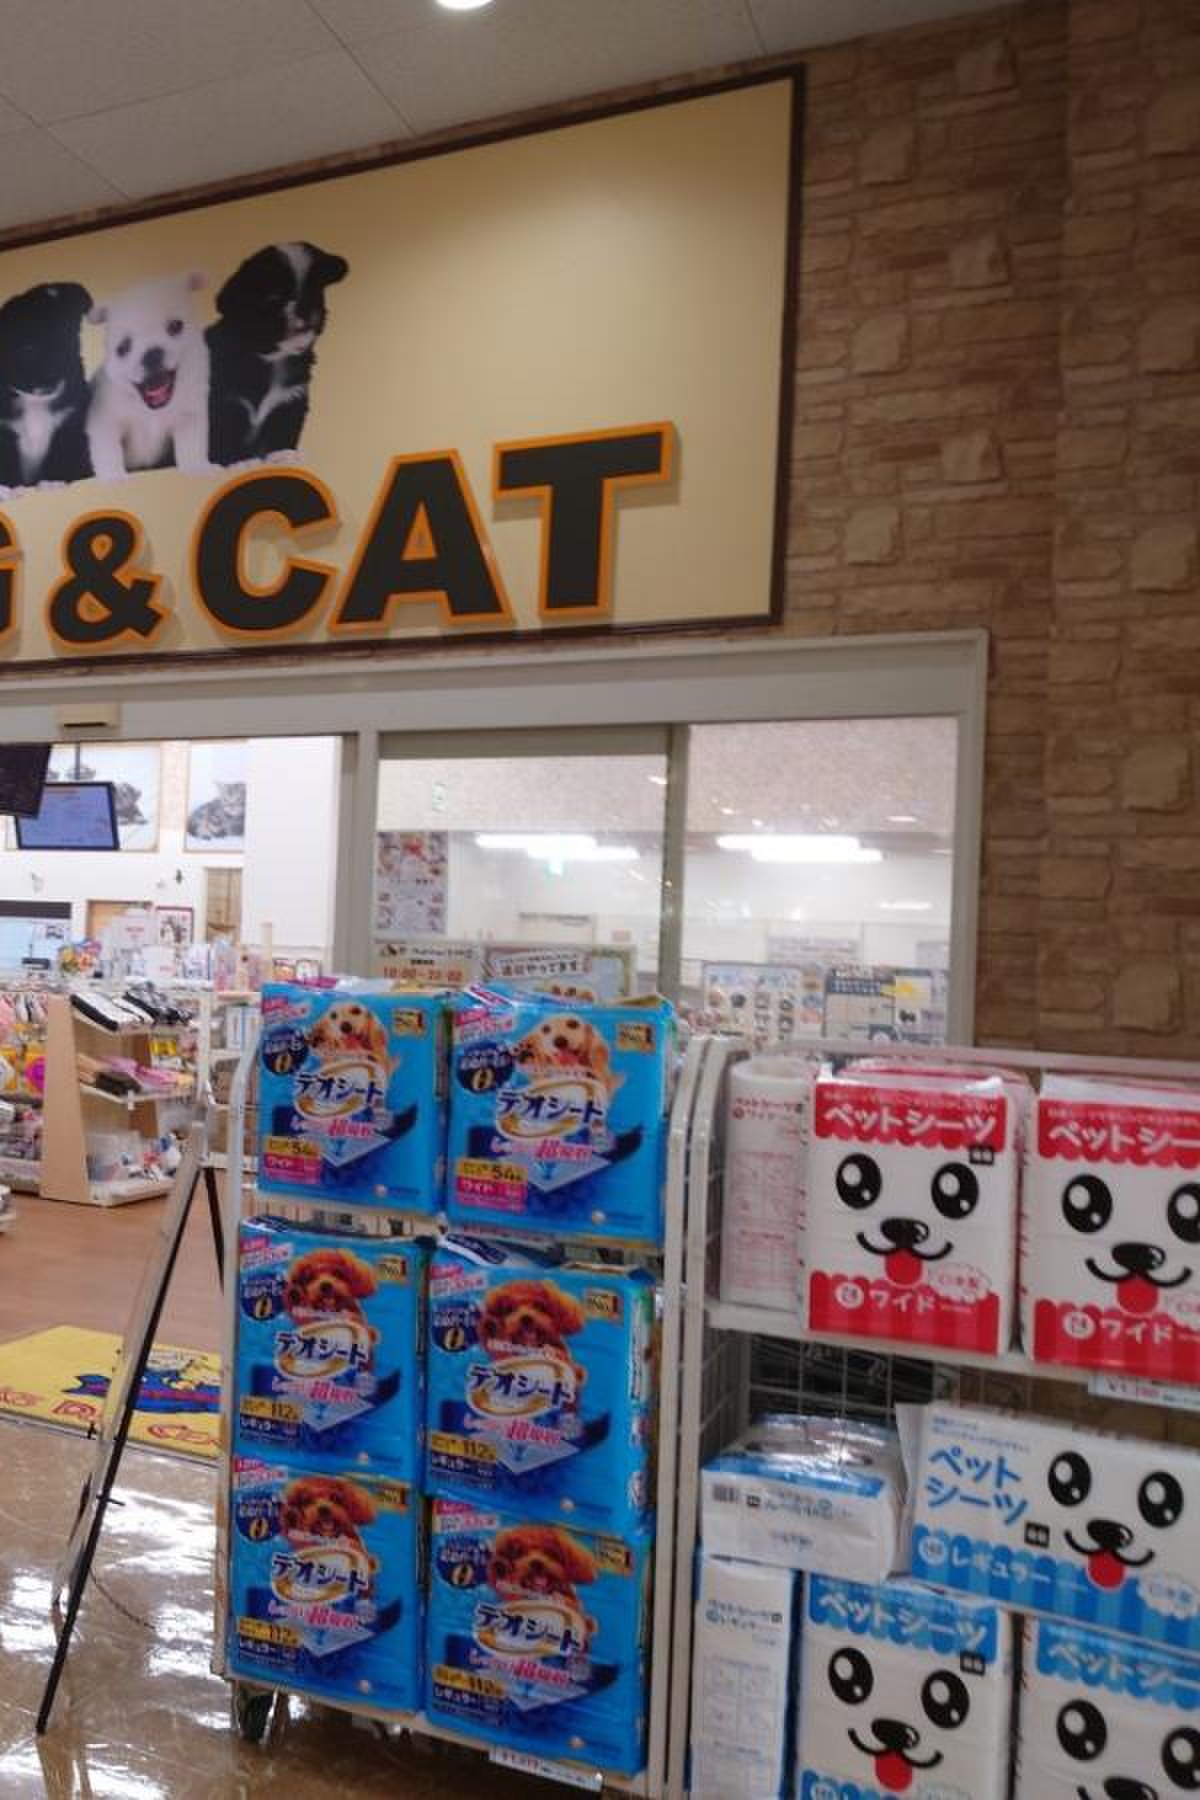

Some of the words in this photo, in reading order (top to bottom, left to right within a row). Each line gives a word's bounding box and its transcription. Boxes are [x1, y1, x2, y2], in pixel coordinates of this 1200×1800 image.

[48, 509, 169, 649] &
[194, 422, 674, 640] CAT
[297, 1074, 384, 1105] デオシート
[498, 1091, 603, 1123] デオシート
[823, 1102, 997, 1143] ペットシーツ
[1048, 1119, 1200, 1154] ペットシー
[869, 1289, 936, 1316] ワイド
[277, 1333, 367, 1370] デオシート
[1099, 1319, 1173, 1345] ワイド
[469, 1366, 573, 1405] デオシート
[928, 1446, 1021, 1489] ペット
[925, 1476, 1028, 1526] シーツ
[273, 1554, 368, 1593] デオシート
[951, 1545, 1052, 1585] レギュラー
[476, 1605, 583, 1652] デオシート
[819, 1592, 988, 1650] ペットシーツ
